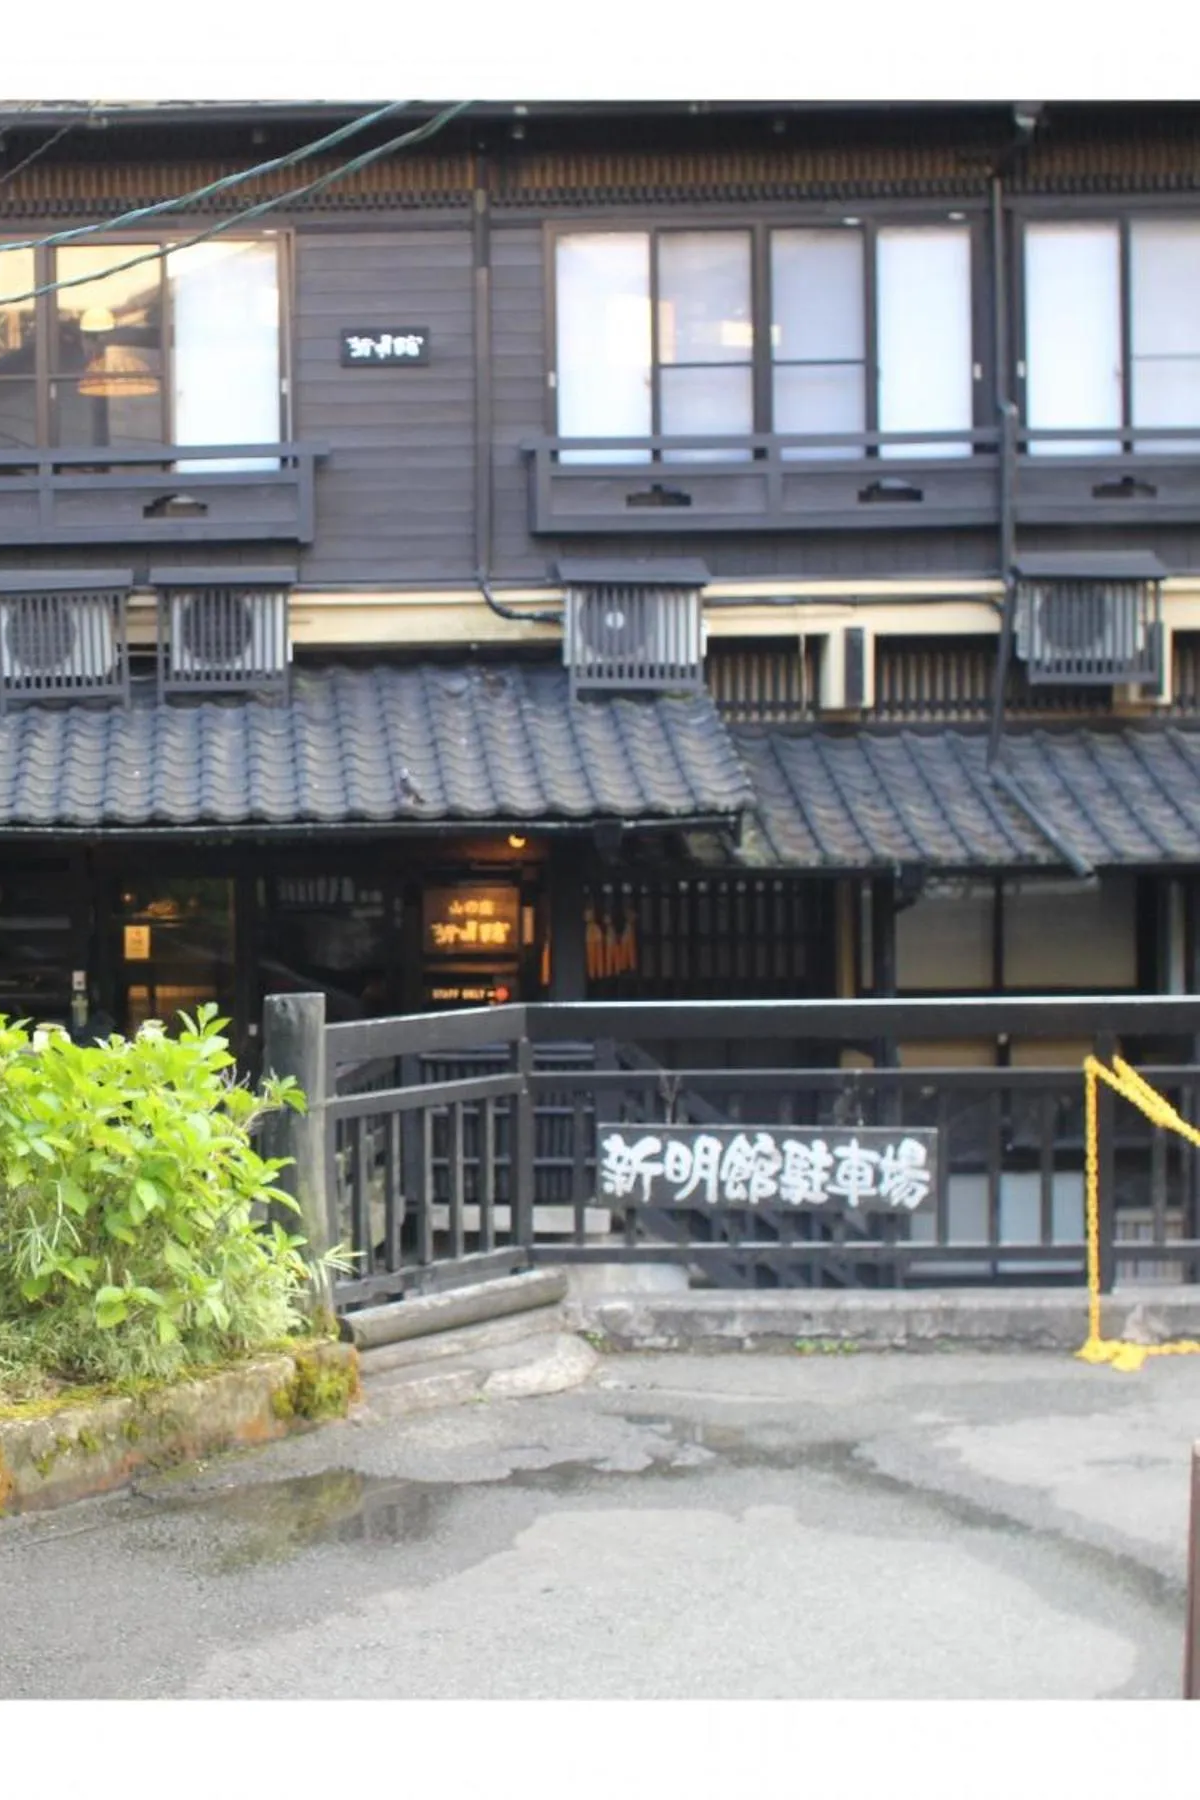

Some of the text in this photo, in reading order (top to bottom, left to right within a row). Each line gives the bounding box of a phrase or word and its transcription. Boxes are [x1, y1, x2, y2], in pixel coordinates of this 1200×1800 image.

[601, 1133, 931, 1210] 新明館駐車場
